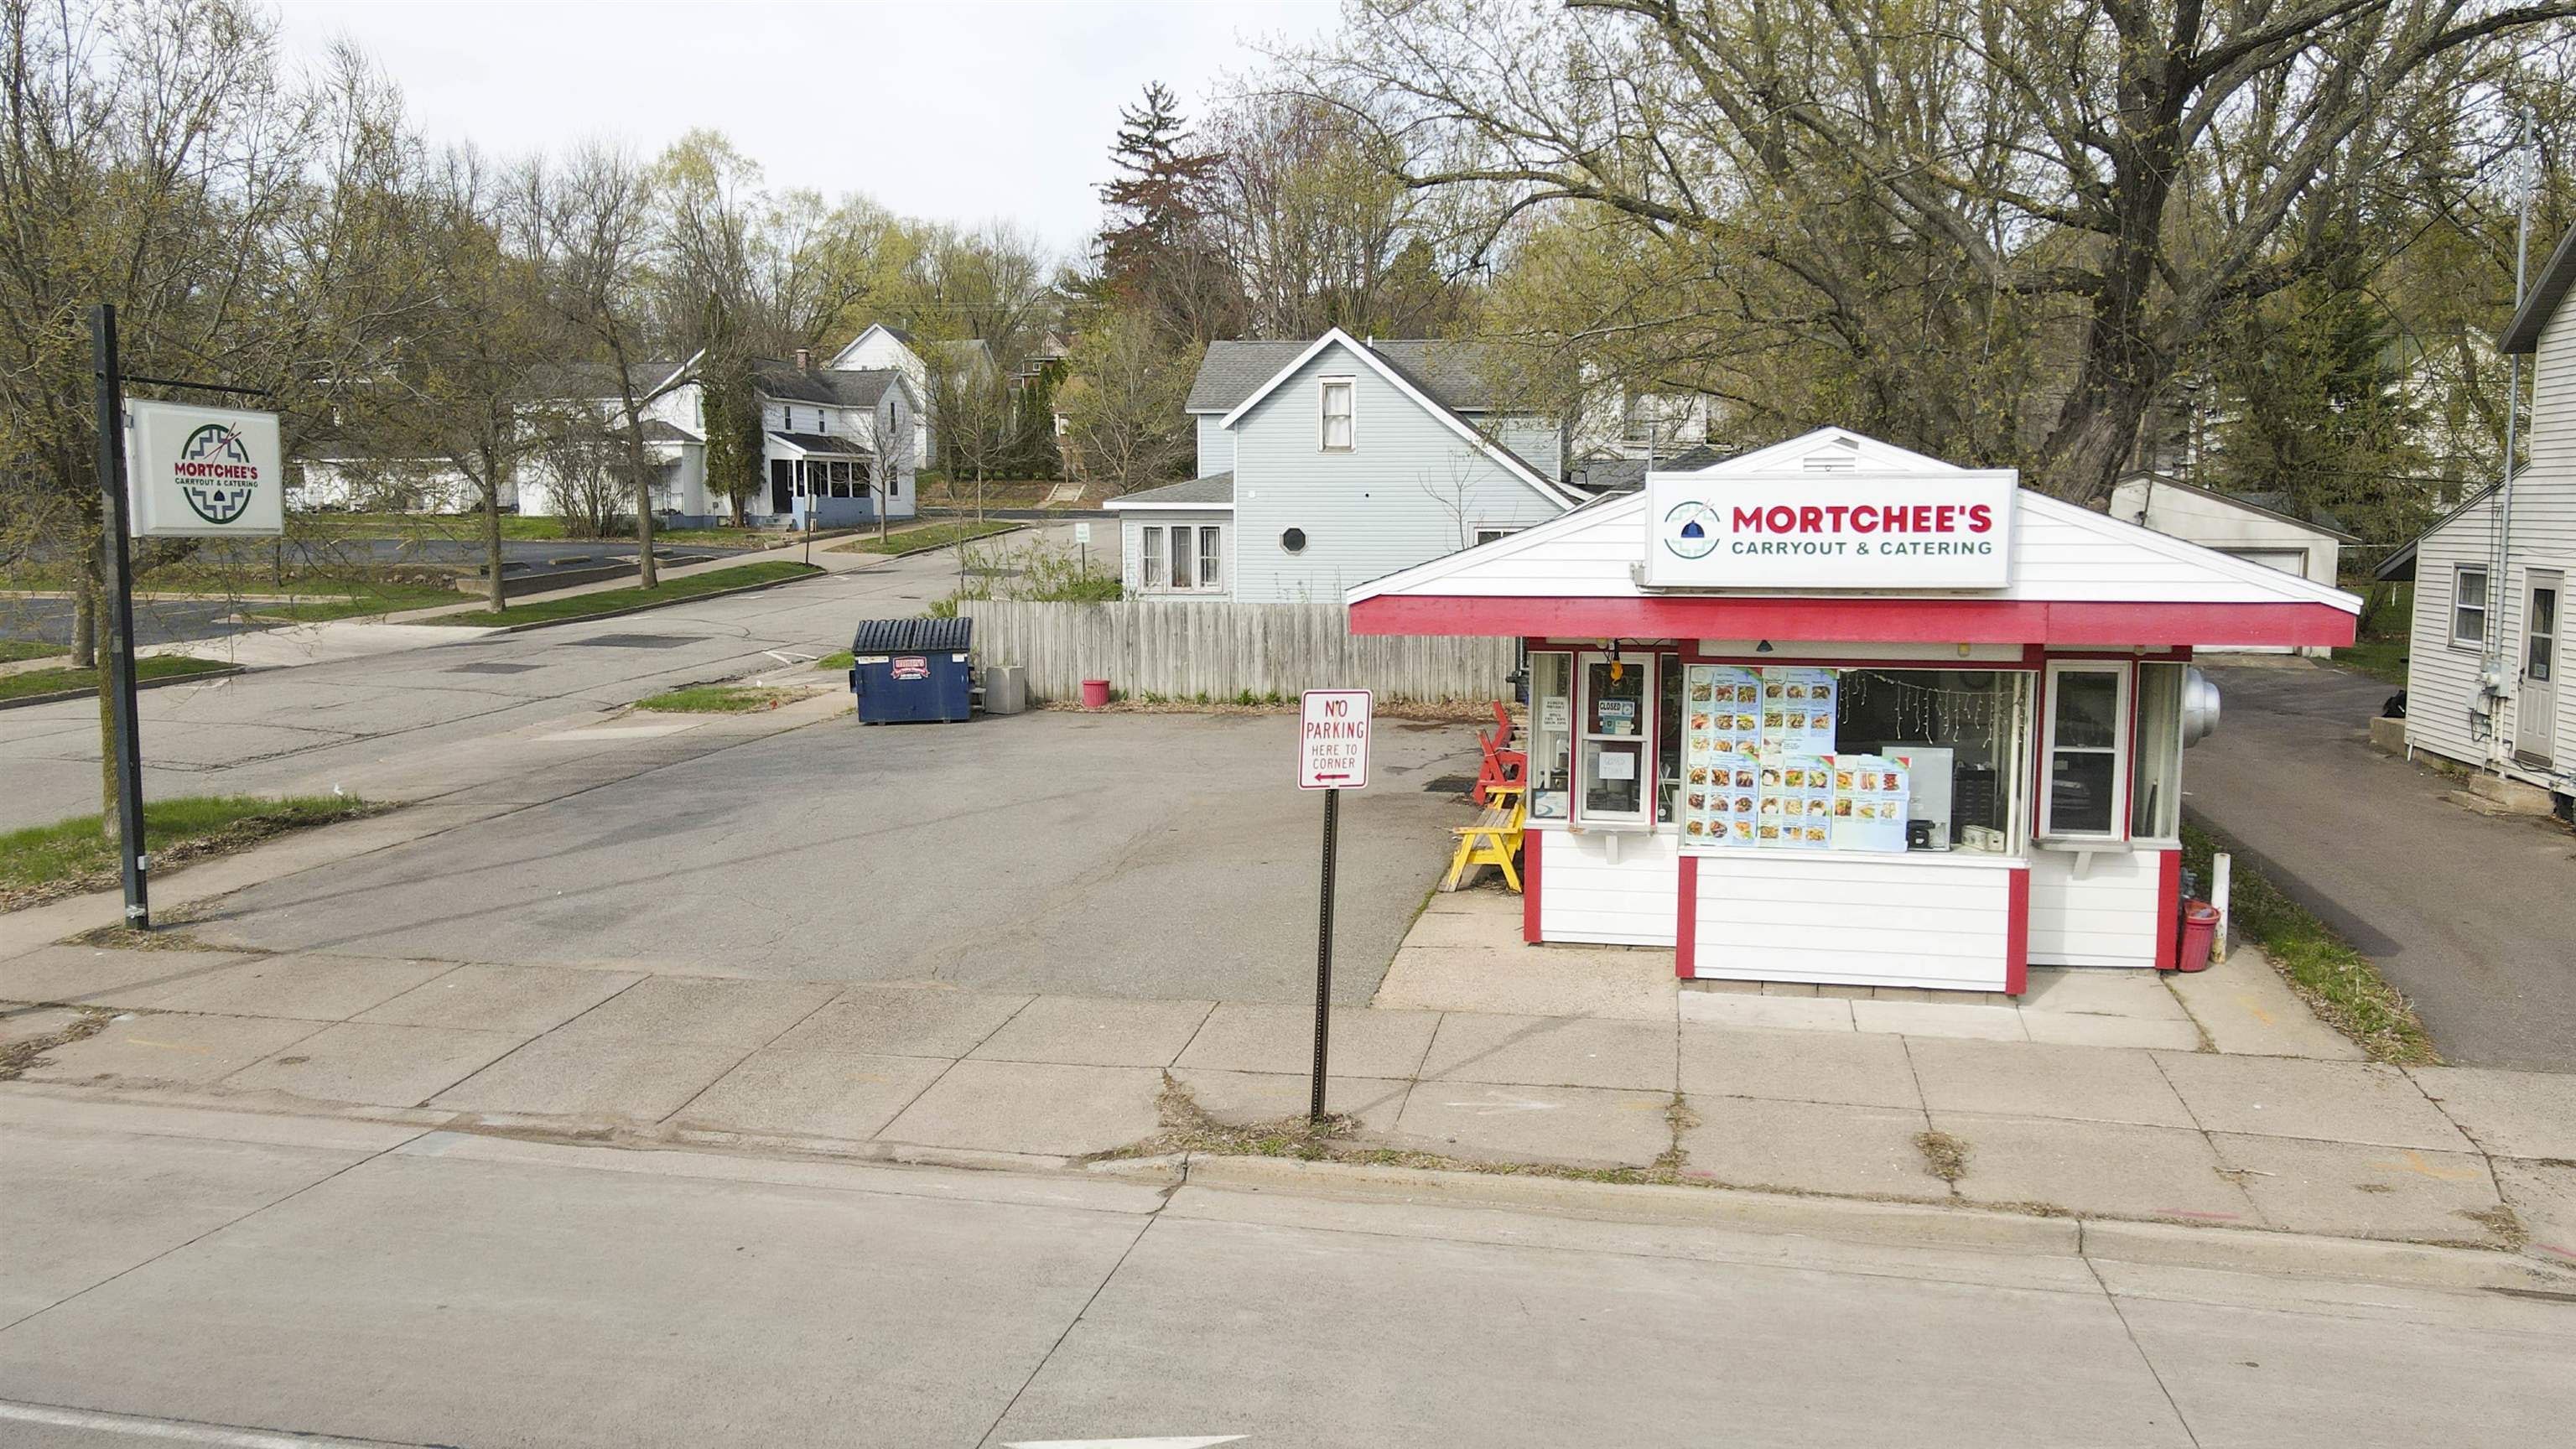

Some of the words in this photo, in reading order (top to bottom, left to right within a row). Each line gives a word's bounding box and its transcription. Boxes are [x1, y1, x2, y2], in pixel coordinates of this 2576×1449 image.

[174, 463, 258, 480] MORTCHEE'S
[174, 477, 214, 486] CARRYOUT
[224, 480, 258, 488] CATERING
[1732, 504, 1992, 534] MORTCHEE'S
[1732, 542, 1847, 555] CARRYOUT
[1857, 542, 1869, 555] &
[1880, 542, 1992, 555] CATERING
[1325, 700, 1348, 717] NO
[1599, 701, 1621, 711] CLOSED
[1306, 722, 1363, 739] PARKING
[1311, 745, 1339, 756] HERE
[1346, 744, 1358, 756] TO
[1312, 757, 1355, 770] CORNER
